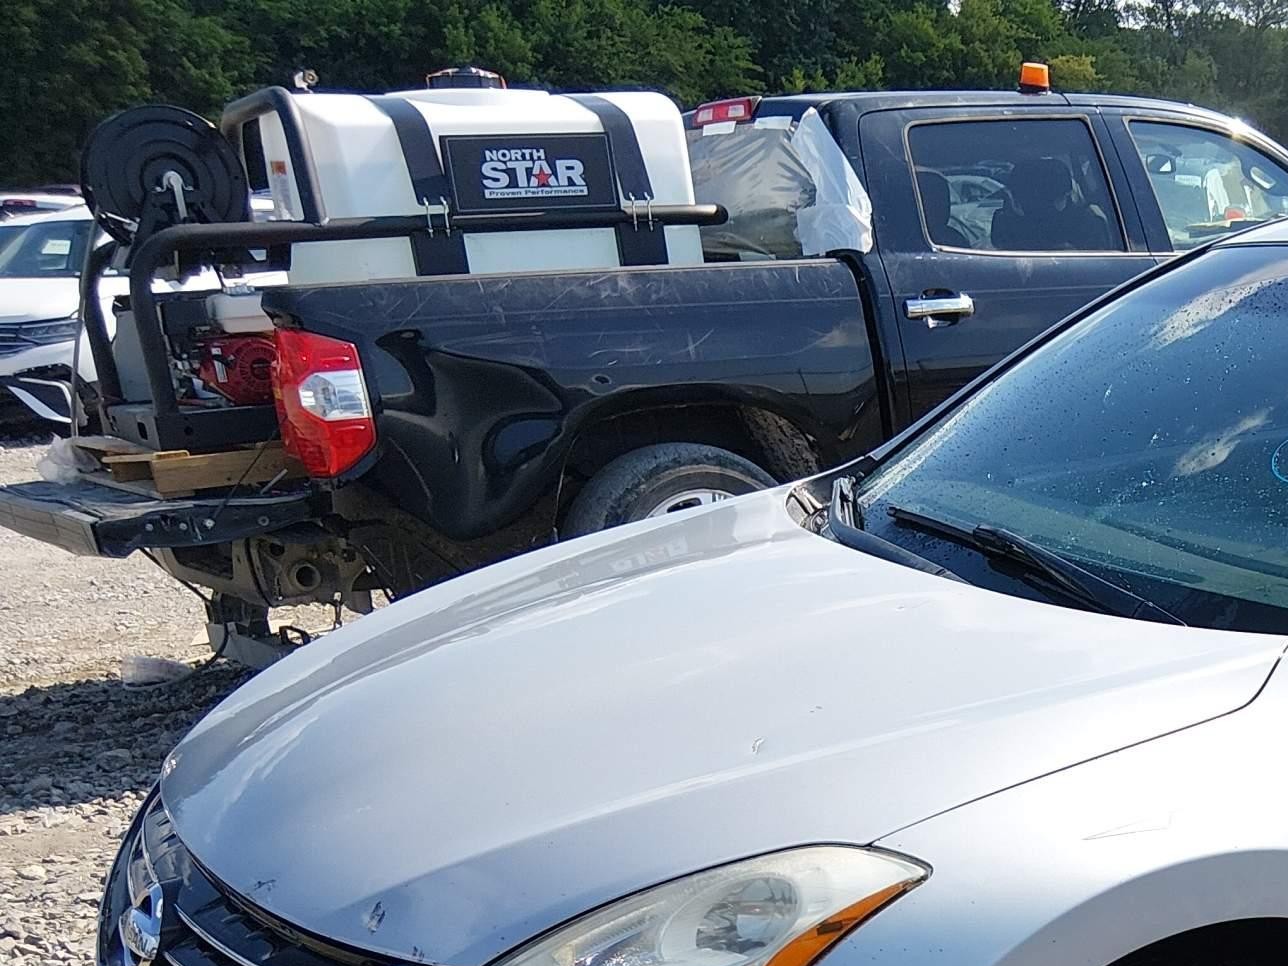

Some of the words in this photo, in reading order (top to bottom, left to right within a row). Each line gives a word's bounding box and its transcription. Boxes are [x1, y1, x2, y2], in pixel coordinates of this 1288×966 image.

[485, 149, 545, 162] NORTH
[481, 159, 587, 188] STAR
[489, 189, 522, 197] Proven
[525, 187, 585, 196] Performance
